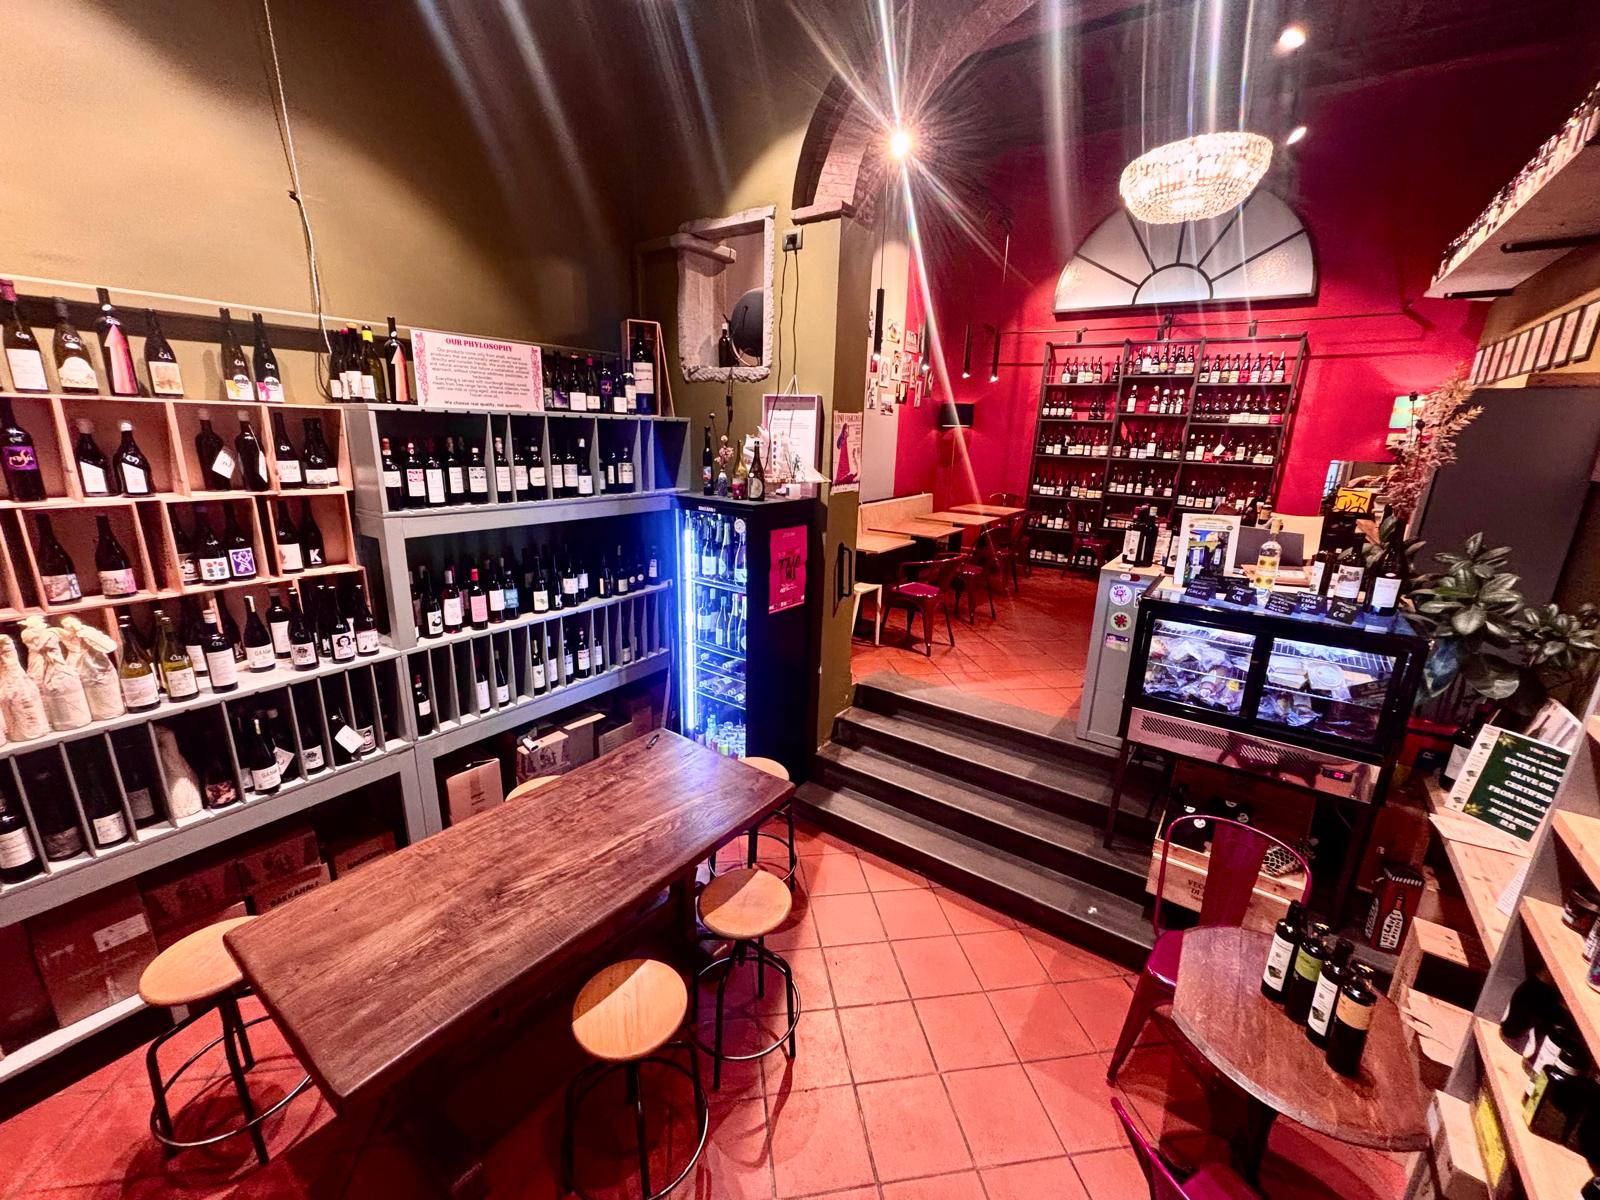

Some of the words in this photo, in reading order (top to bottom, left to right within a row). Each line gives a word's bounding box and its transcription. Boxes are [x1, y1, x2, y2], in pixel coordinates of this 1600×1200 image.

[445, 338, 462, 346] OUR
[463, 340, 512, 352] PHYLOSOPHY
[1504, 756, 1537, 773] EXTRA
[1504, 780, 1553, 803] CERTIFIED
[1510, 770, 1540, 786] OLIVE
[1538, 781, 1555, 792] OIL
[1487, 784, 1516, 800] FROM
[1515, 795, 1549, 814] TUSCA
